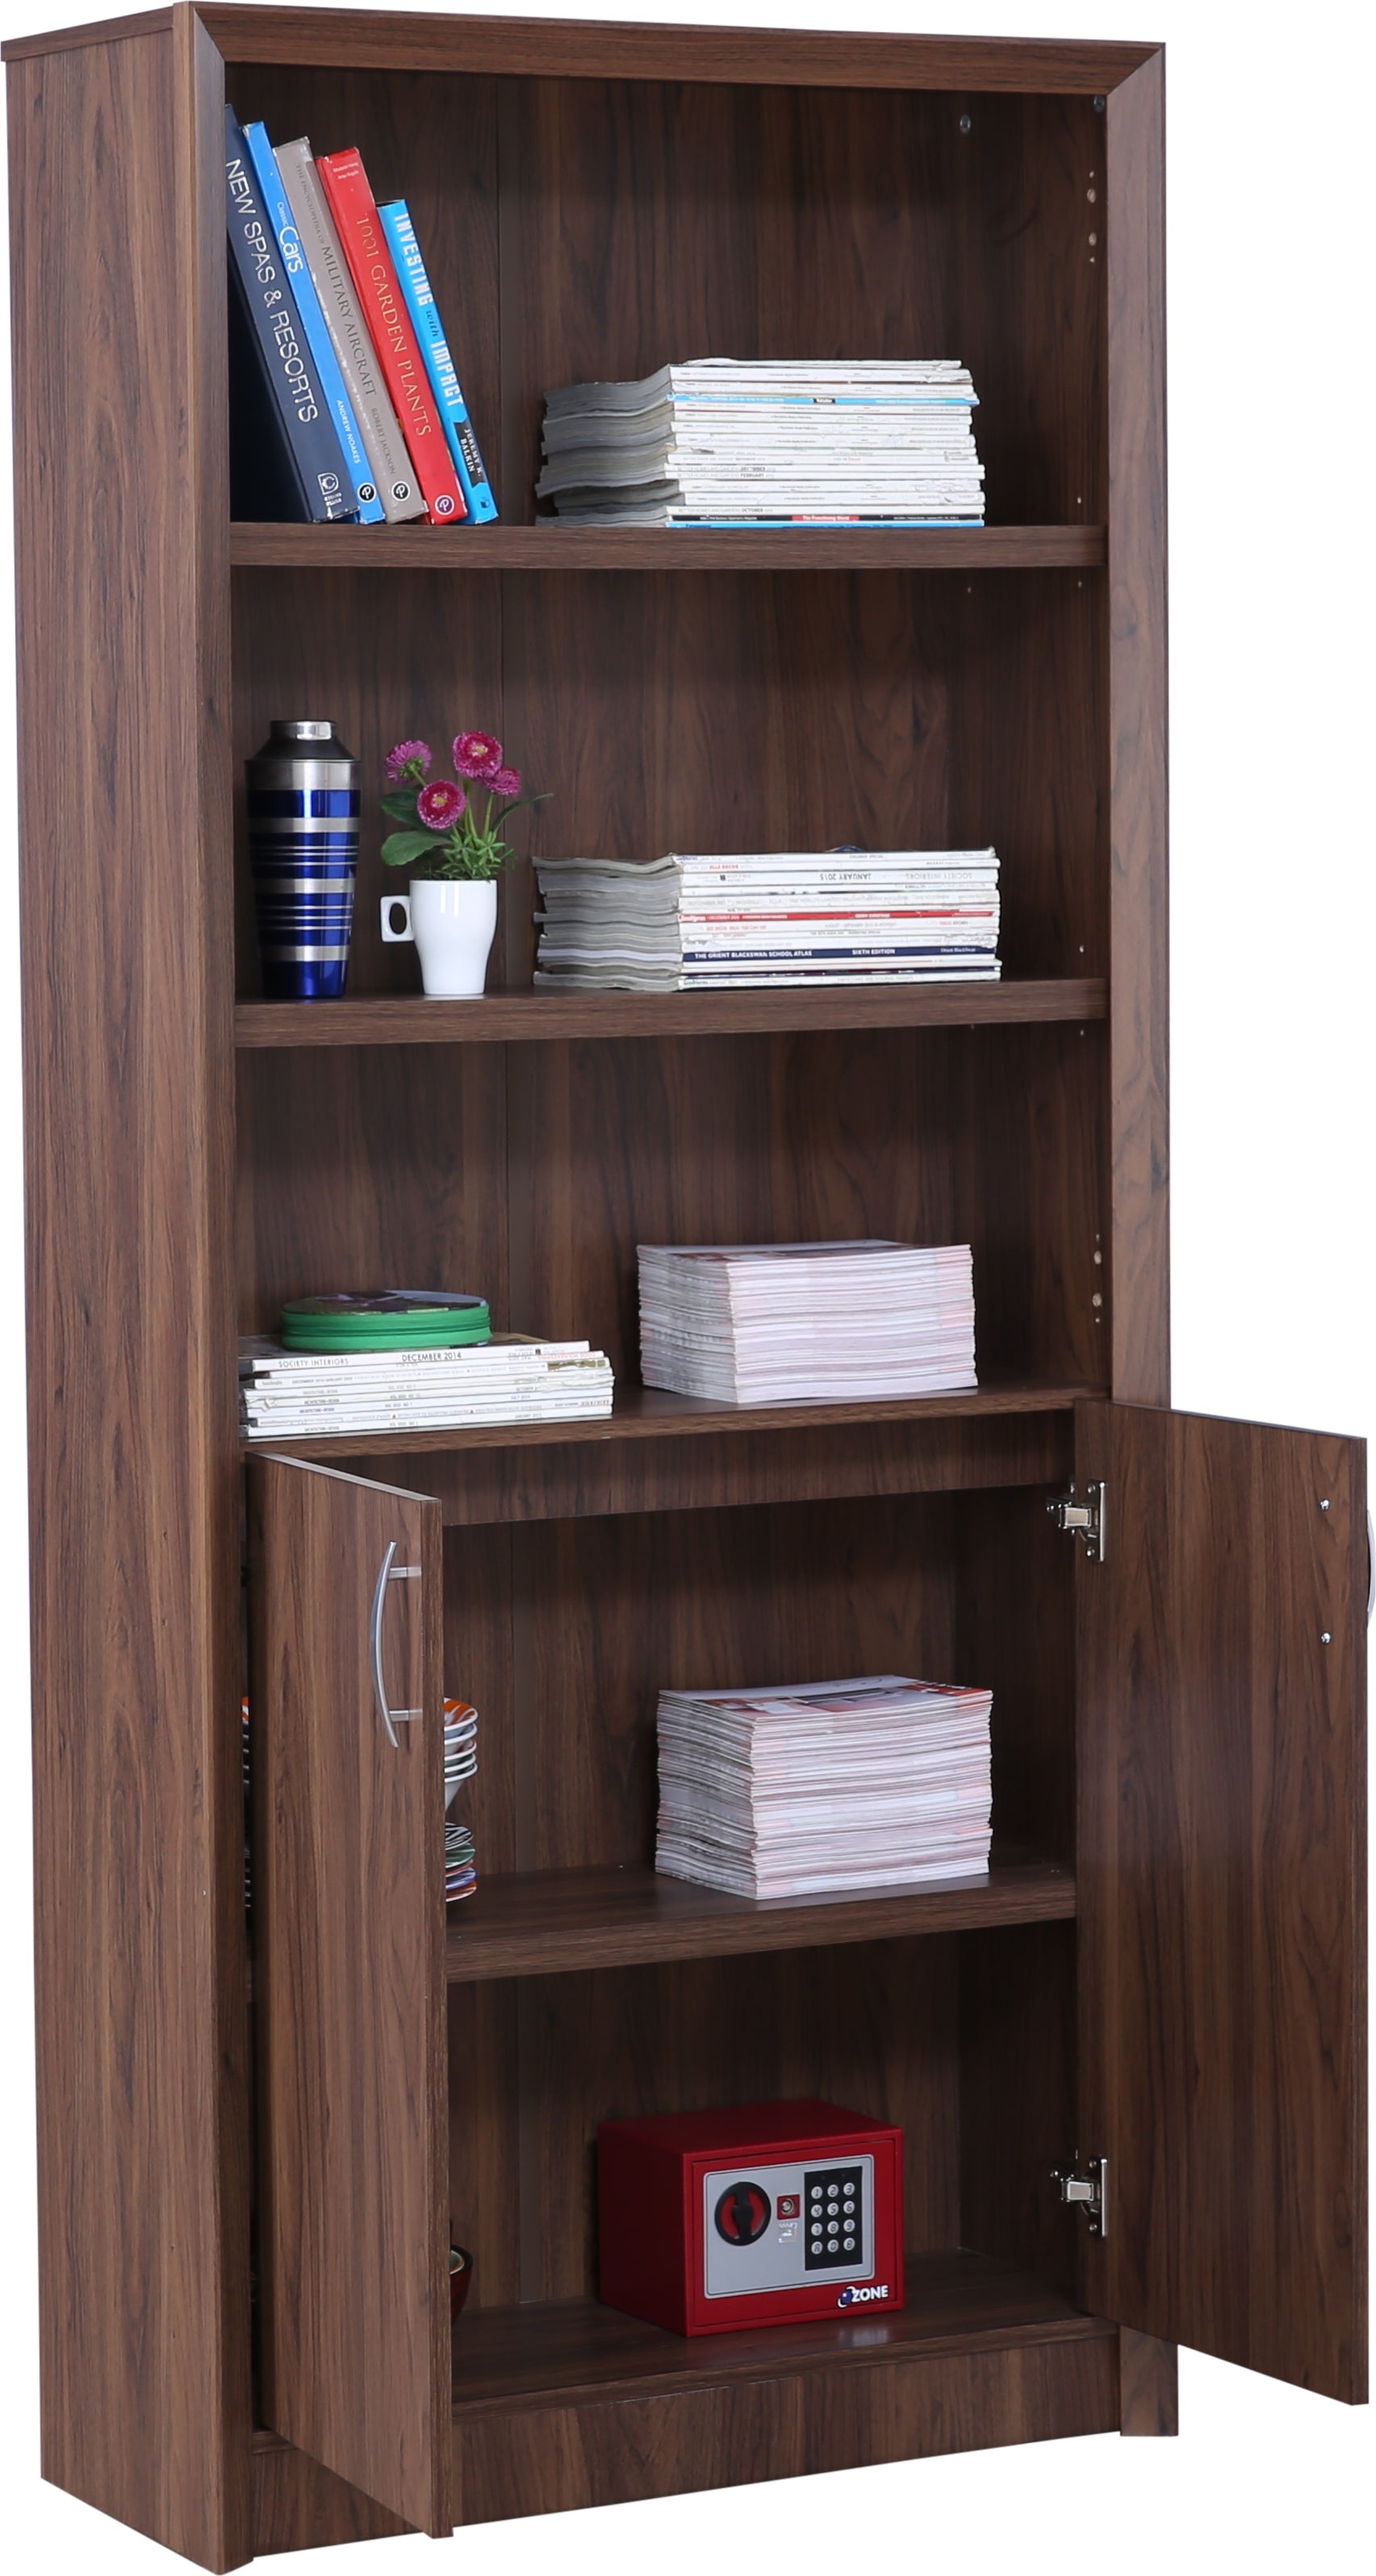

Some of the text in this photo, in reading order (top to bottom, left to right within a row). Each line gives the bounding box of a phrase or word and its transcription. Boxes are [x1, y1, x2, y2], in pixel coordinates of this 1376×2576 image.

[279, 226, 303, 273] Cars
[226, 159, 318, 422] NEW SPAS & RESORTS
[322, 247, 353, 319] MILITARY
[345, 324, 376, 395] AIRCRAFT
[394, 213, 463, 407] INVESTING with IMPACT
[357, 215, 432, 436] 1001 GARDEN PLANTS
[337, 400, 361, 464] ANDREW NOAKES
[371, 407, 395, 474] ROBERT JACKSON
[461, 438, 475, 472] BALKIN
[820, 873, 836, 881] 2015
[278, 1358, 349, 1368] SOCIETY INTERIORS
[402, 1351, 462, 1362] DECEMBER 2014
